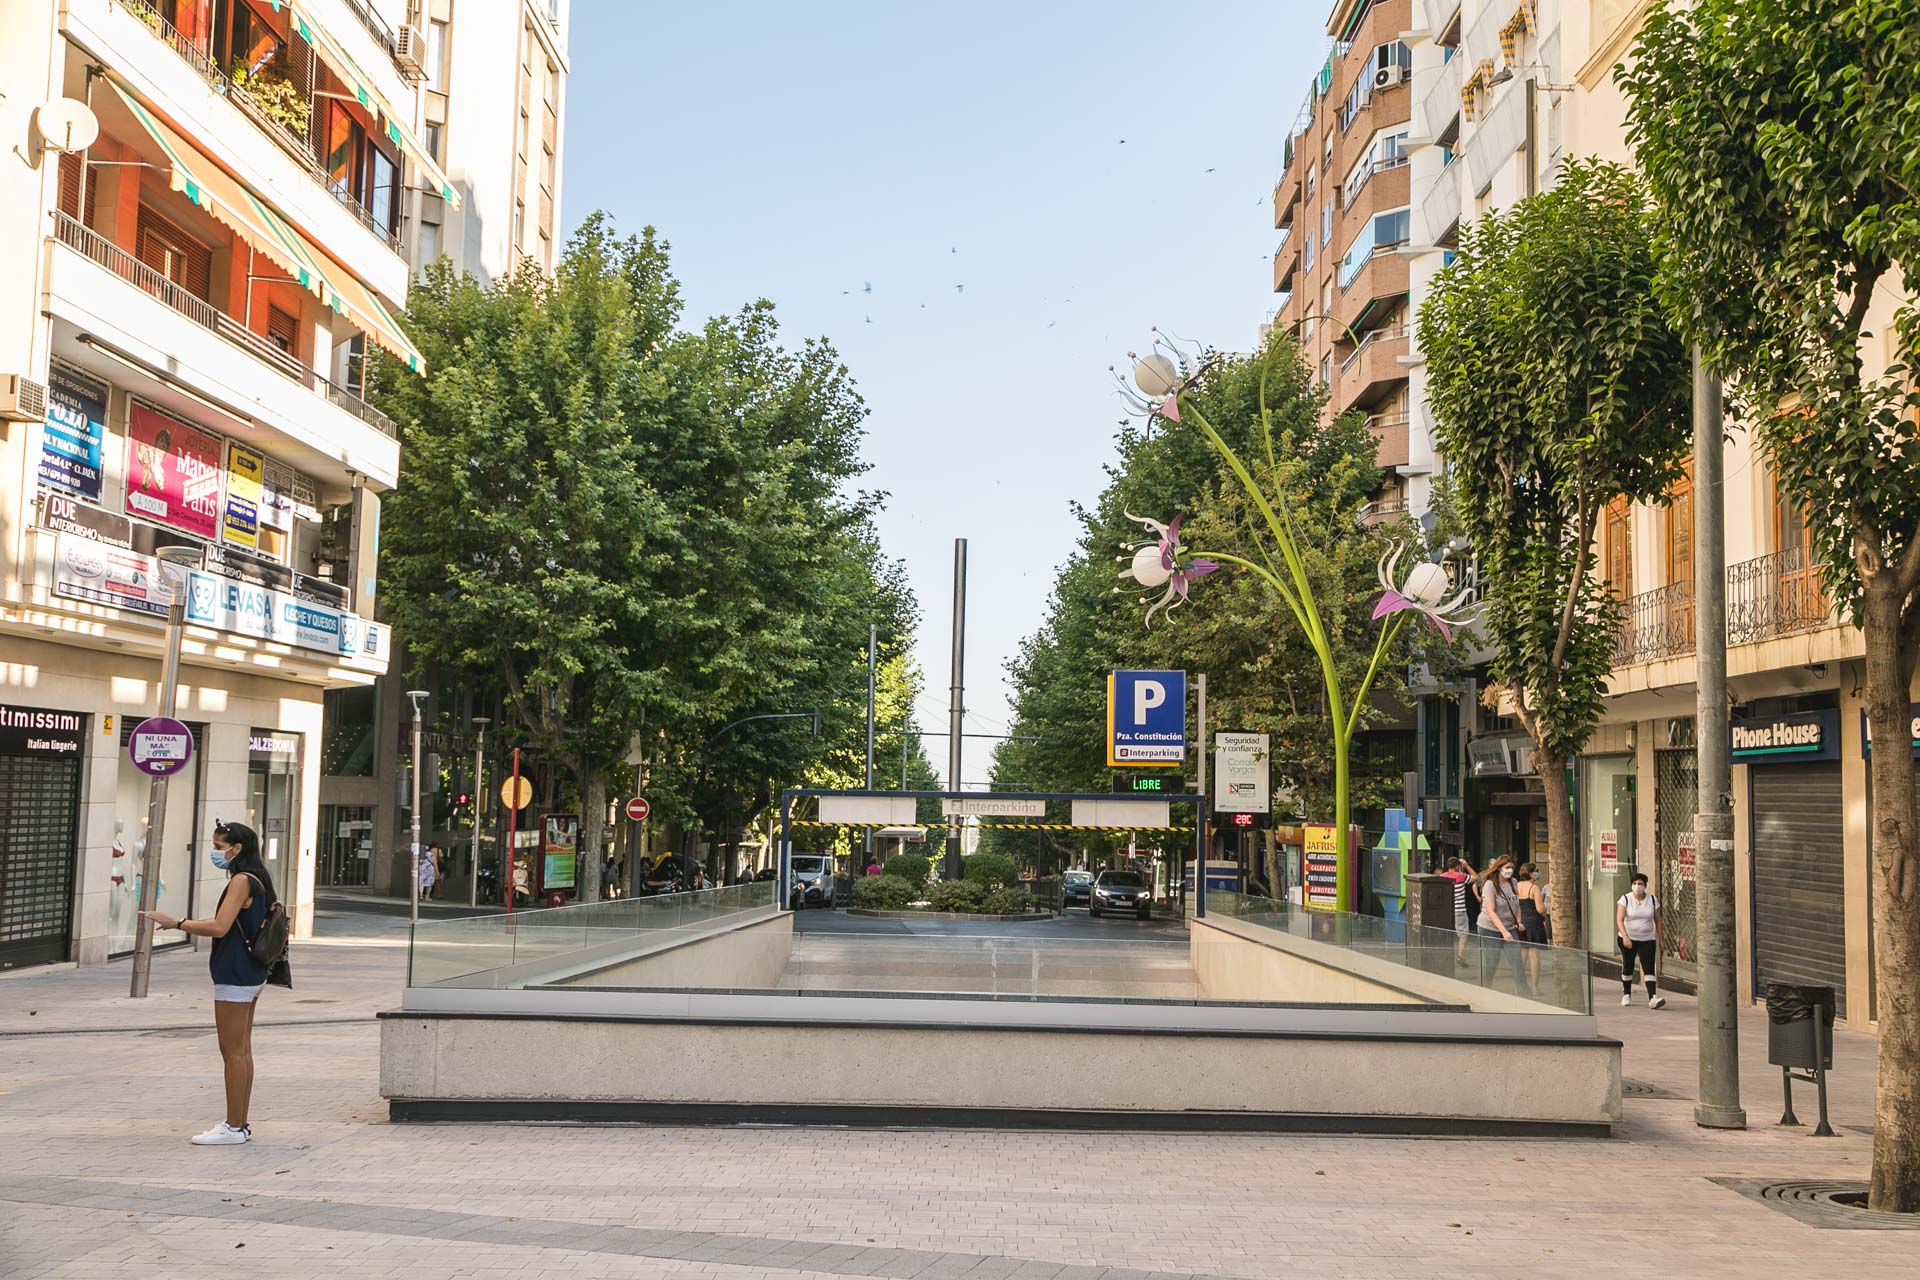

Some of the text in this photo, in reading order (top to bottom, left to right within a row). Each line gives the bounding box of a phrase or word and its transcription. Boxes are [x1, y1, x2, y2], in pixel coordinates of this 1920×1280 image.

[51, 496, 76, 521] DUE
[208, 544, 226, 564] DUE
[220, 583, 272, 621] LEVASA
[285, 607, 337, 632] LECHE Y QUESOS
[1134, 680, 1166, 725] P
[1116, 731, 1183, 741] Pza. Constitución
[1224, 736, 1260, 746] Seguridad
[1732, 722, 1821, 749] Phone House
[27, 738, 78, 753] Italian lingerie
[248, 736, 295, 753] CALZEDONIA
[1228, 745, 1262, 753] confianza
[1129, 749, 1180, 758] Interparking
[1228, 766, 1257, 775] Vargas
[1133, 778, 1161, 790] LIBRE
[965, 801, 1037, 814] Interparking
[1306, 841, 1337, 851] JAFRIS
